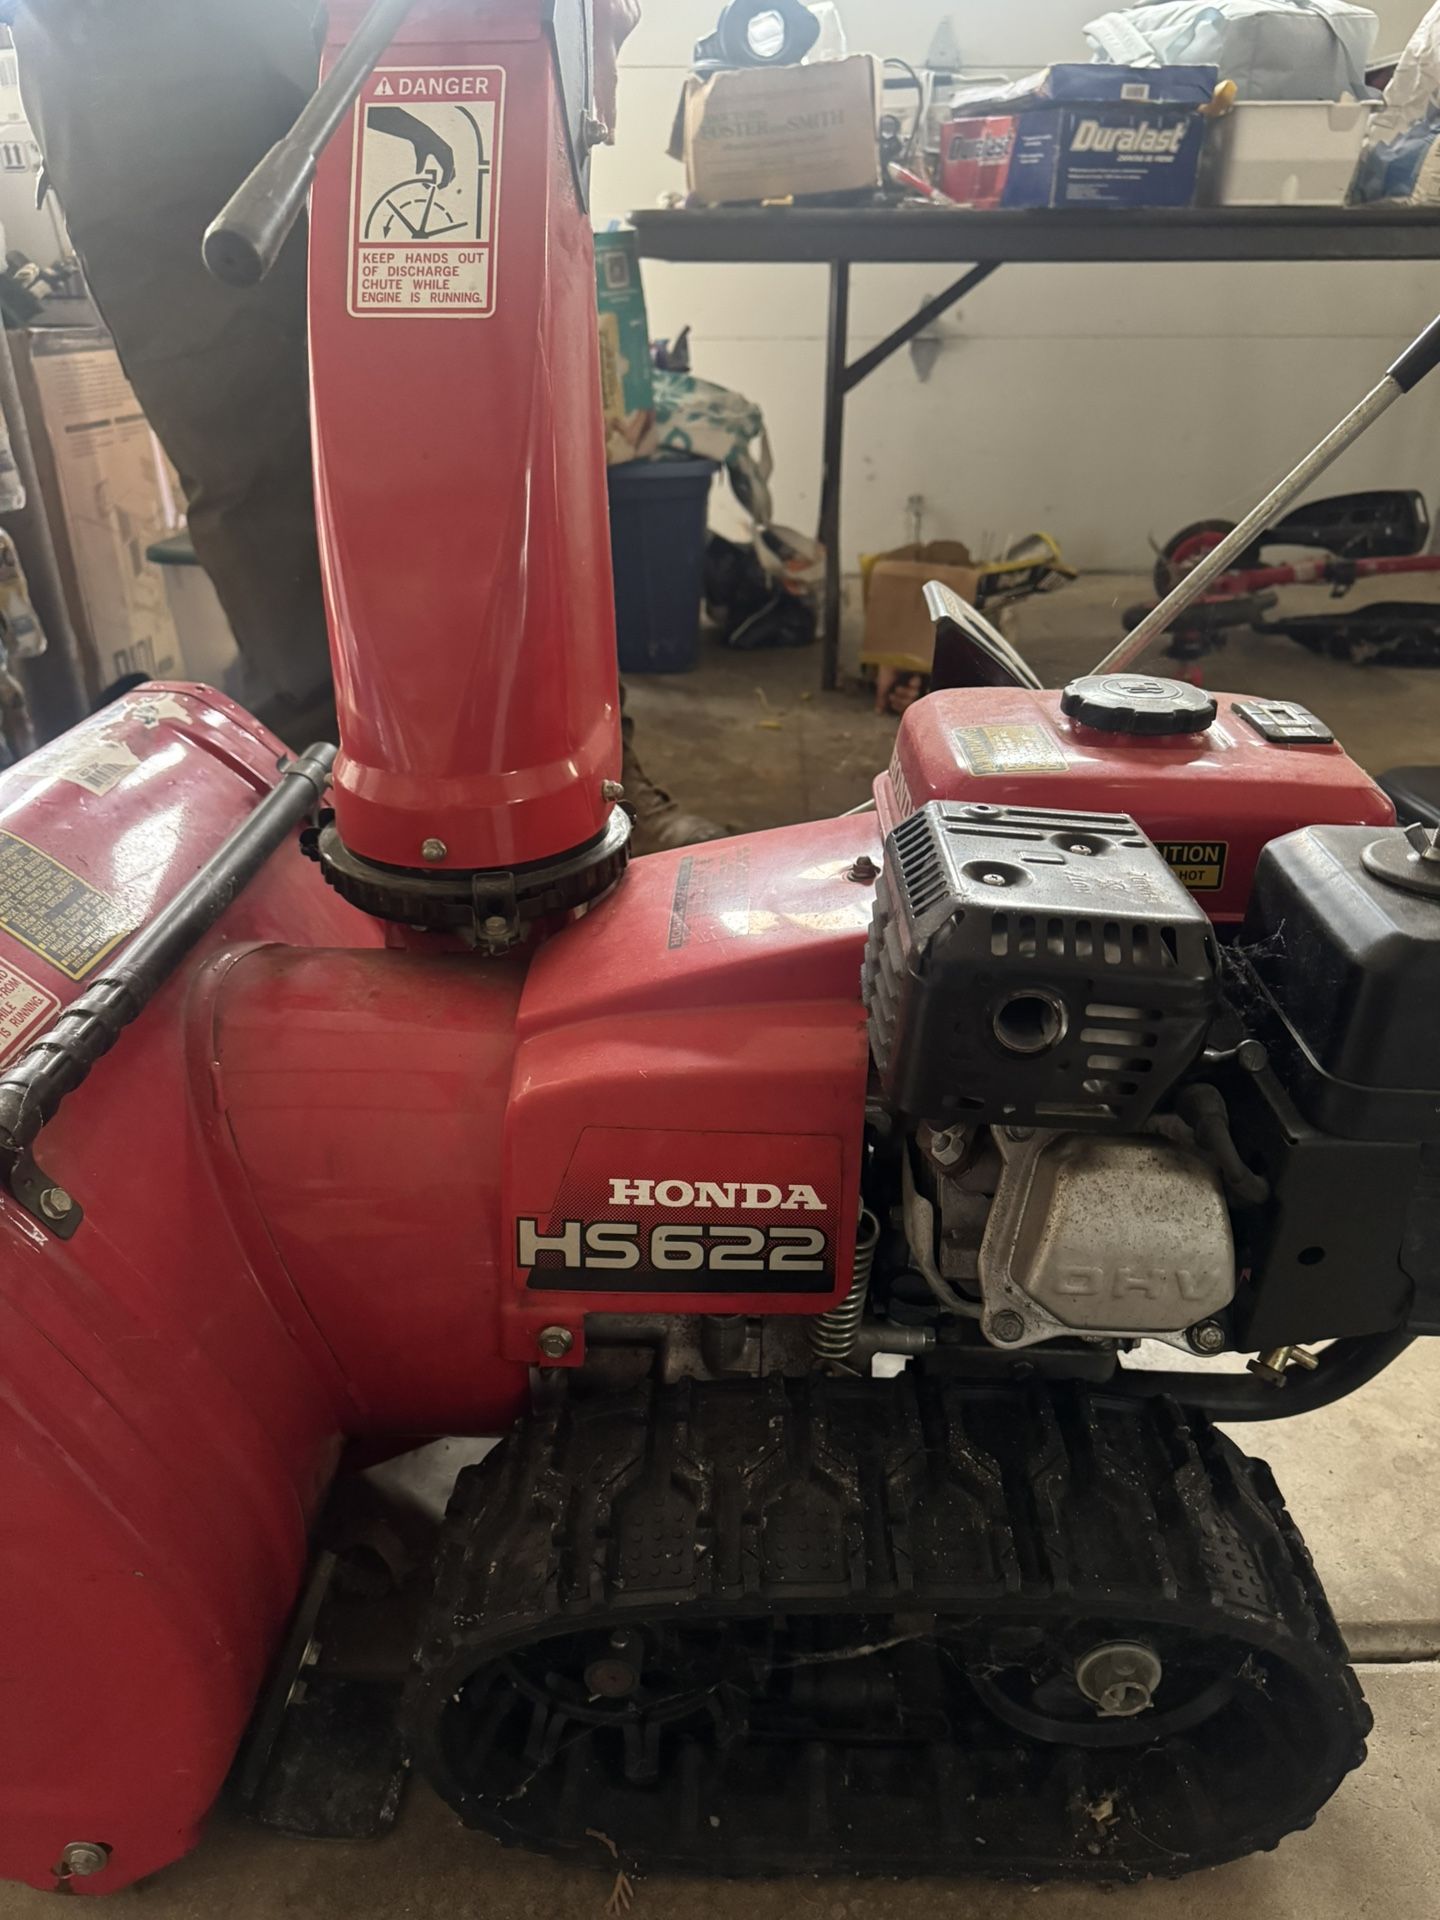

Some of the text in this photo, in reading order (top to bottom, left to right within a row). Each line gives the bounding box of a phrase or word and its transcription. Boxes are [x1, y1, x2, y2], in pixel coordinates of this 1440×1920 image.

[399, 78, 489, 95] DANGER
[1069, 120, 1185, 153] Duralast
[363, 252, 484, 264] KEEP HANDS OUT
[362, 266, 460, 277] OF DISCHARGE
[362, 279, 450, 290] CHUTE WHILE
[362, 292, 483, 303] ENGINE IS RUNNING.
[1179, 870, 1206, 881] HOT
[609, 1178, 827, 1210] HONDA
[517, 1217, 826, 1271] HS622
[1052, 1264, 1222, 1302] OHV
